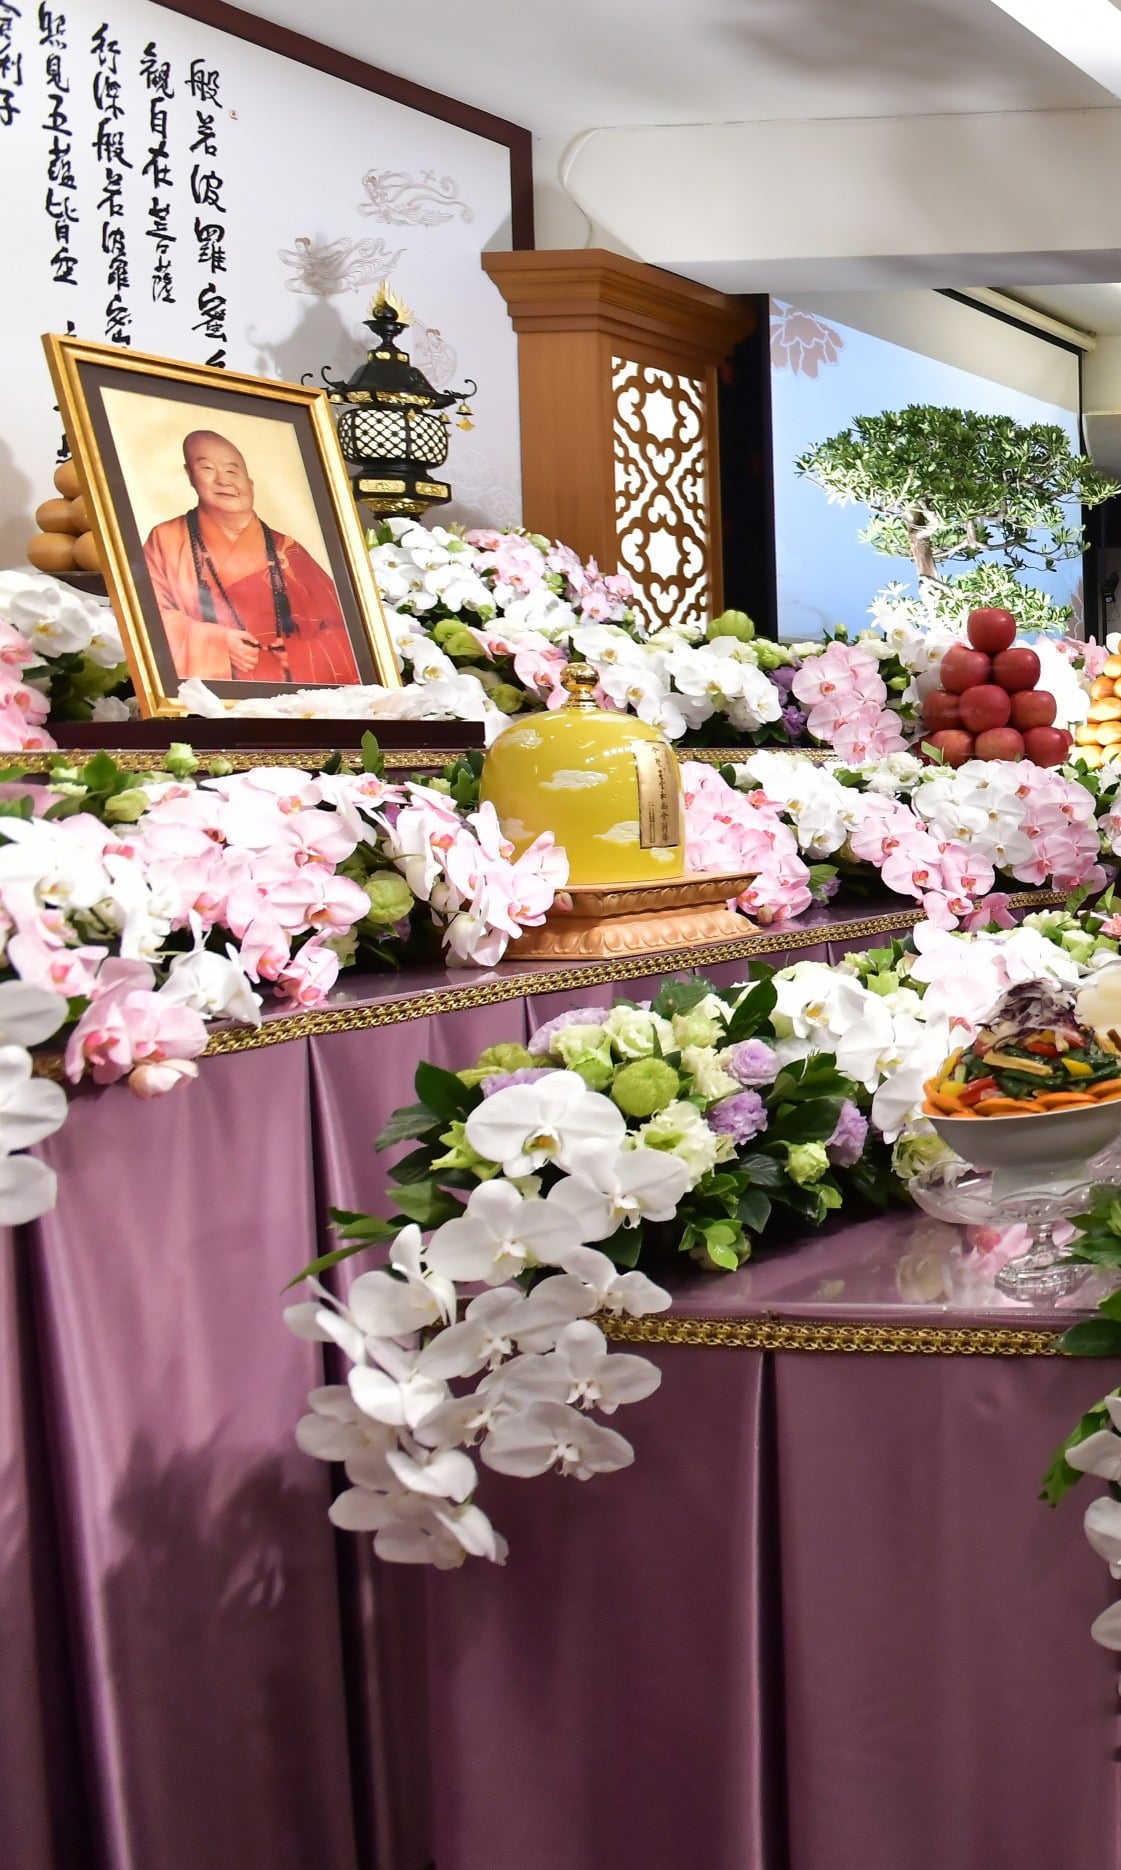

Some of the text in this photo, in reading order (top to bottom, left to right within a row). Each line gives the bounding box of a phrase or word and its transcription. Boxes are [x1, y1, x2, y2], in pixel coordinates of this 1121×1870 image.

[140, 42, 177, 304] 觀自在菩薩
